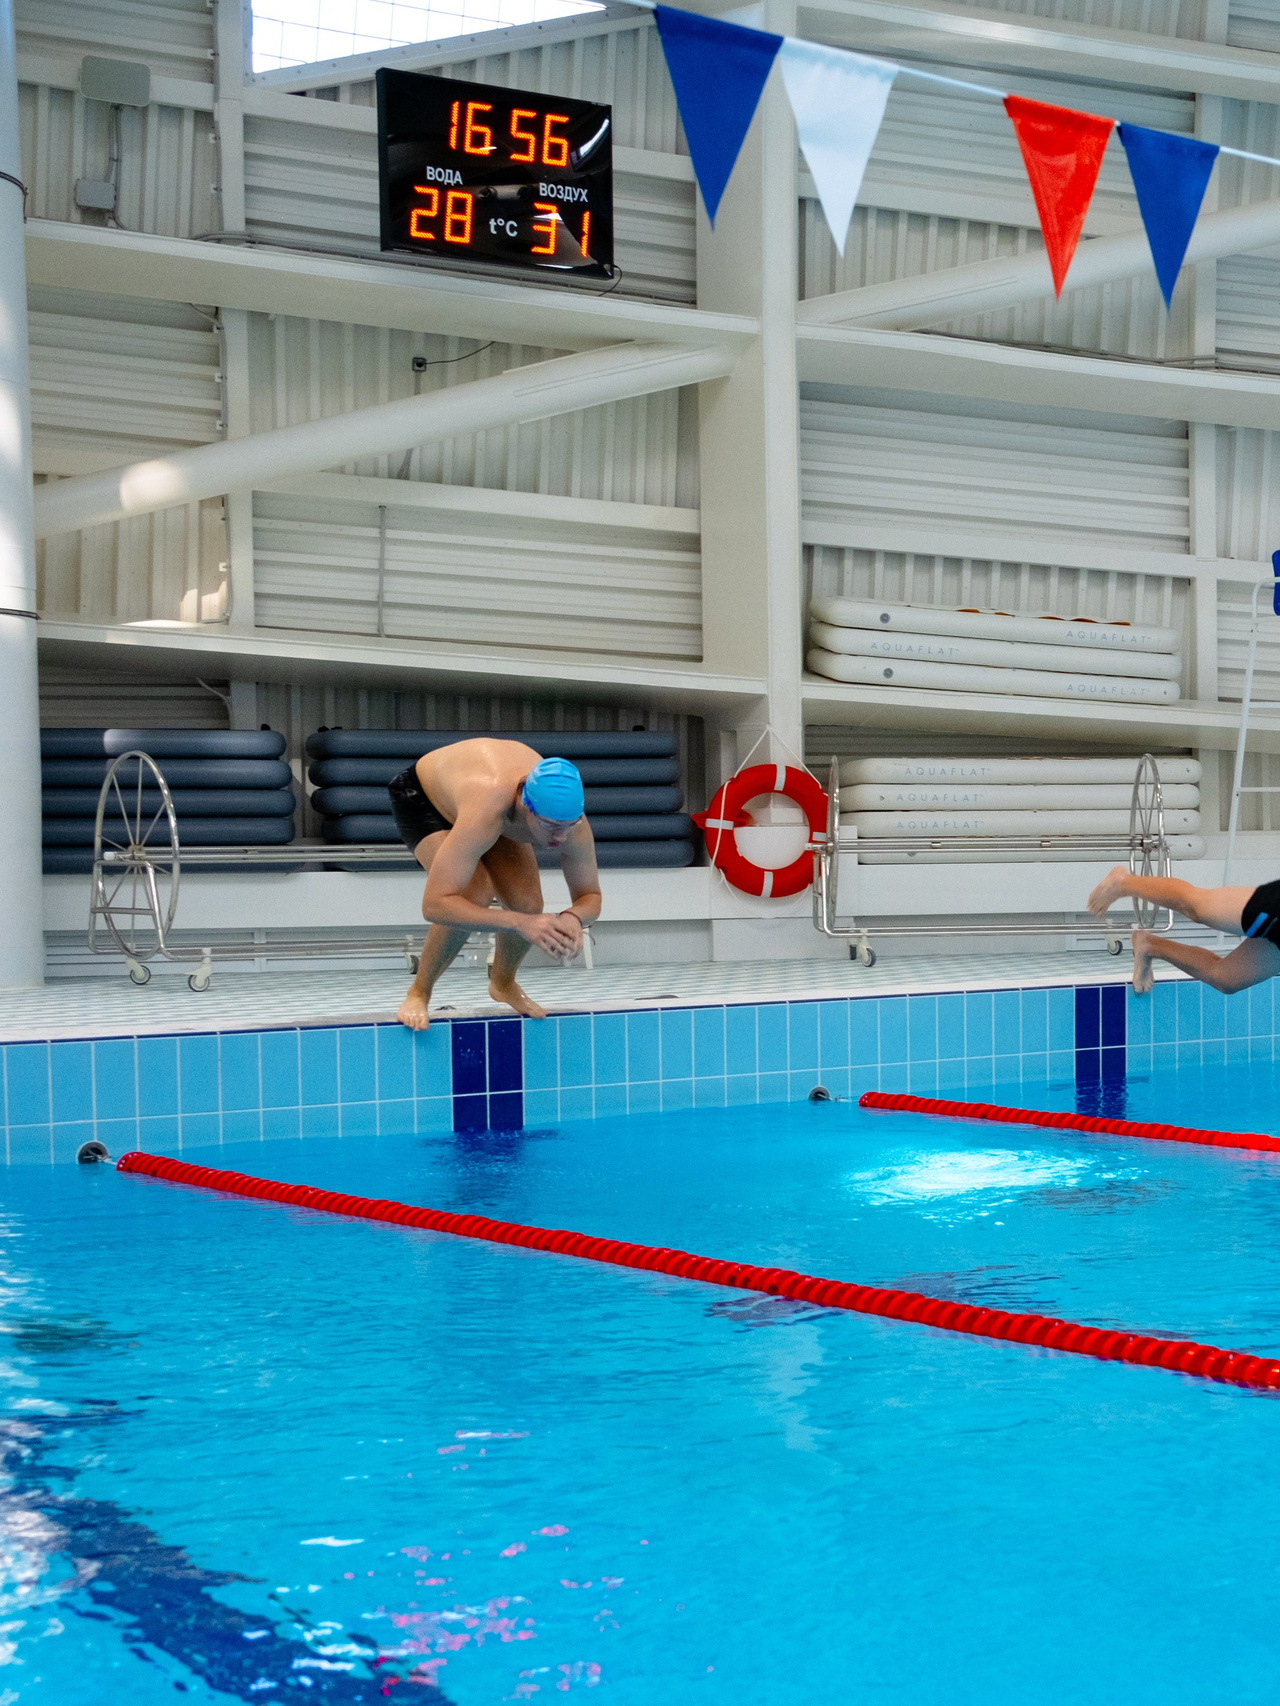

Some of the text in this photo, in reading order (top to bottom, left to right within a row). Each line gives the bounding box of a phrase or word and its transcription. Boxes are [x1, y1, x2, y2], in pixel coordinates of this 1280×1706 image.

[448, 100, 570, 167] 16 56
[426, 166, 463, 185] ВОДА
[539, 183, 589, 203] ВОЗДУХ
[409, 185, 473, 245] 28
[489, 218, 518, 237] t°C
[531, 202, 591, 258] 31
